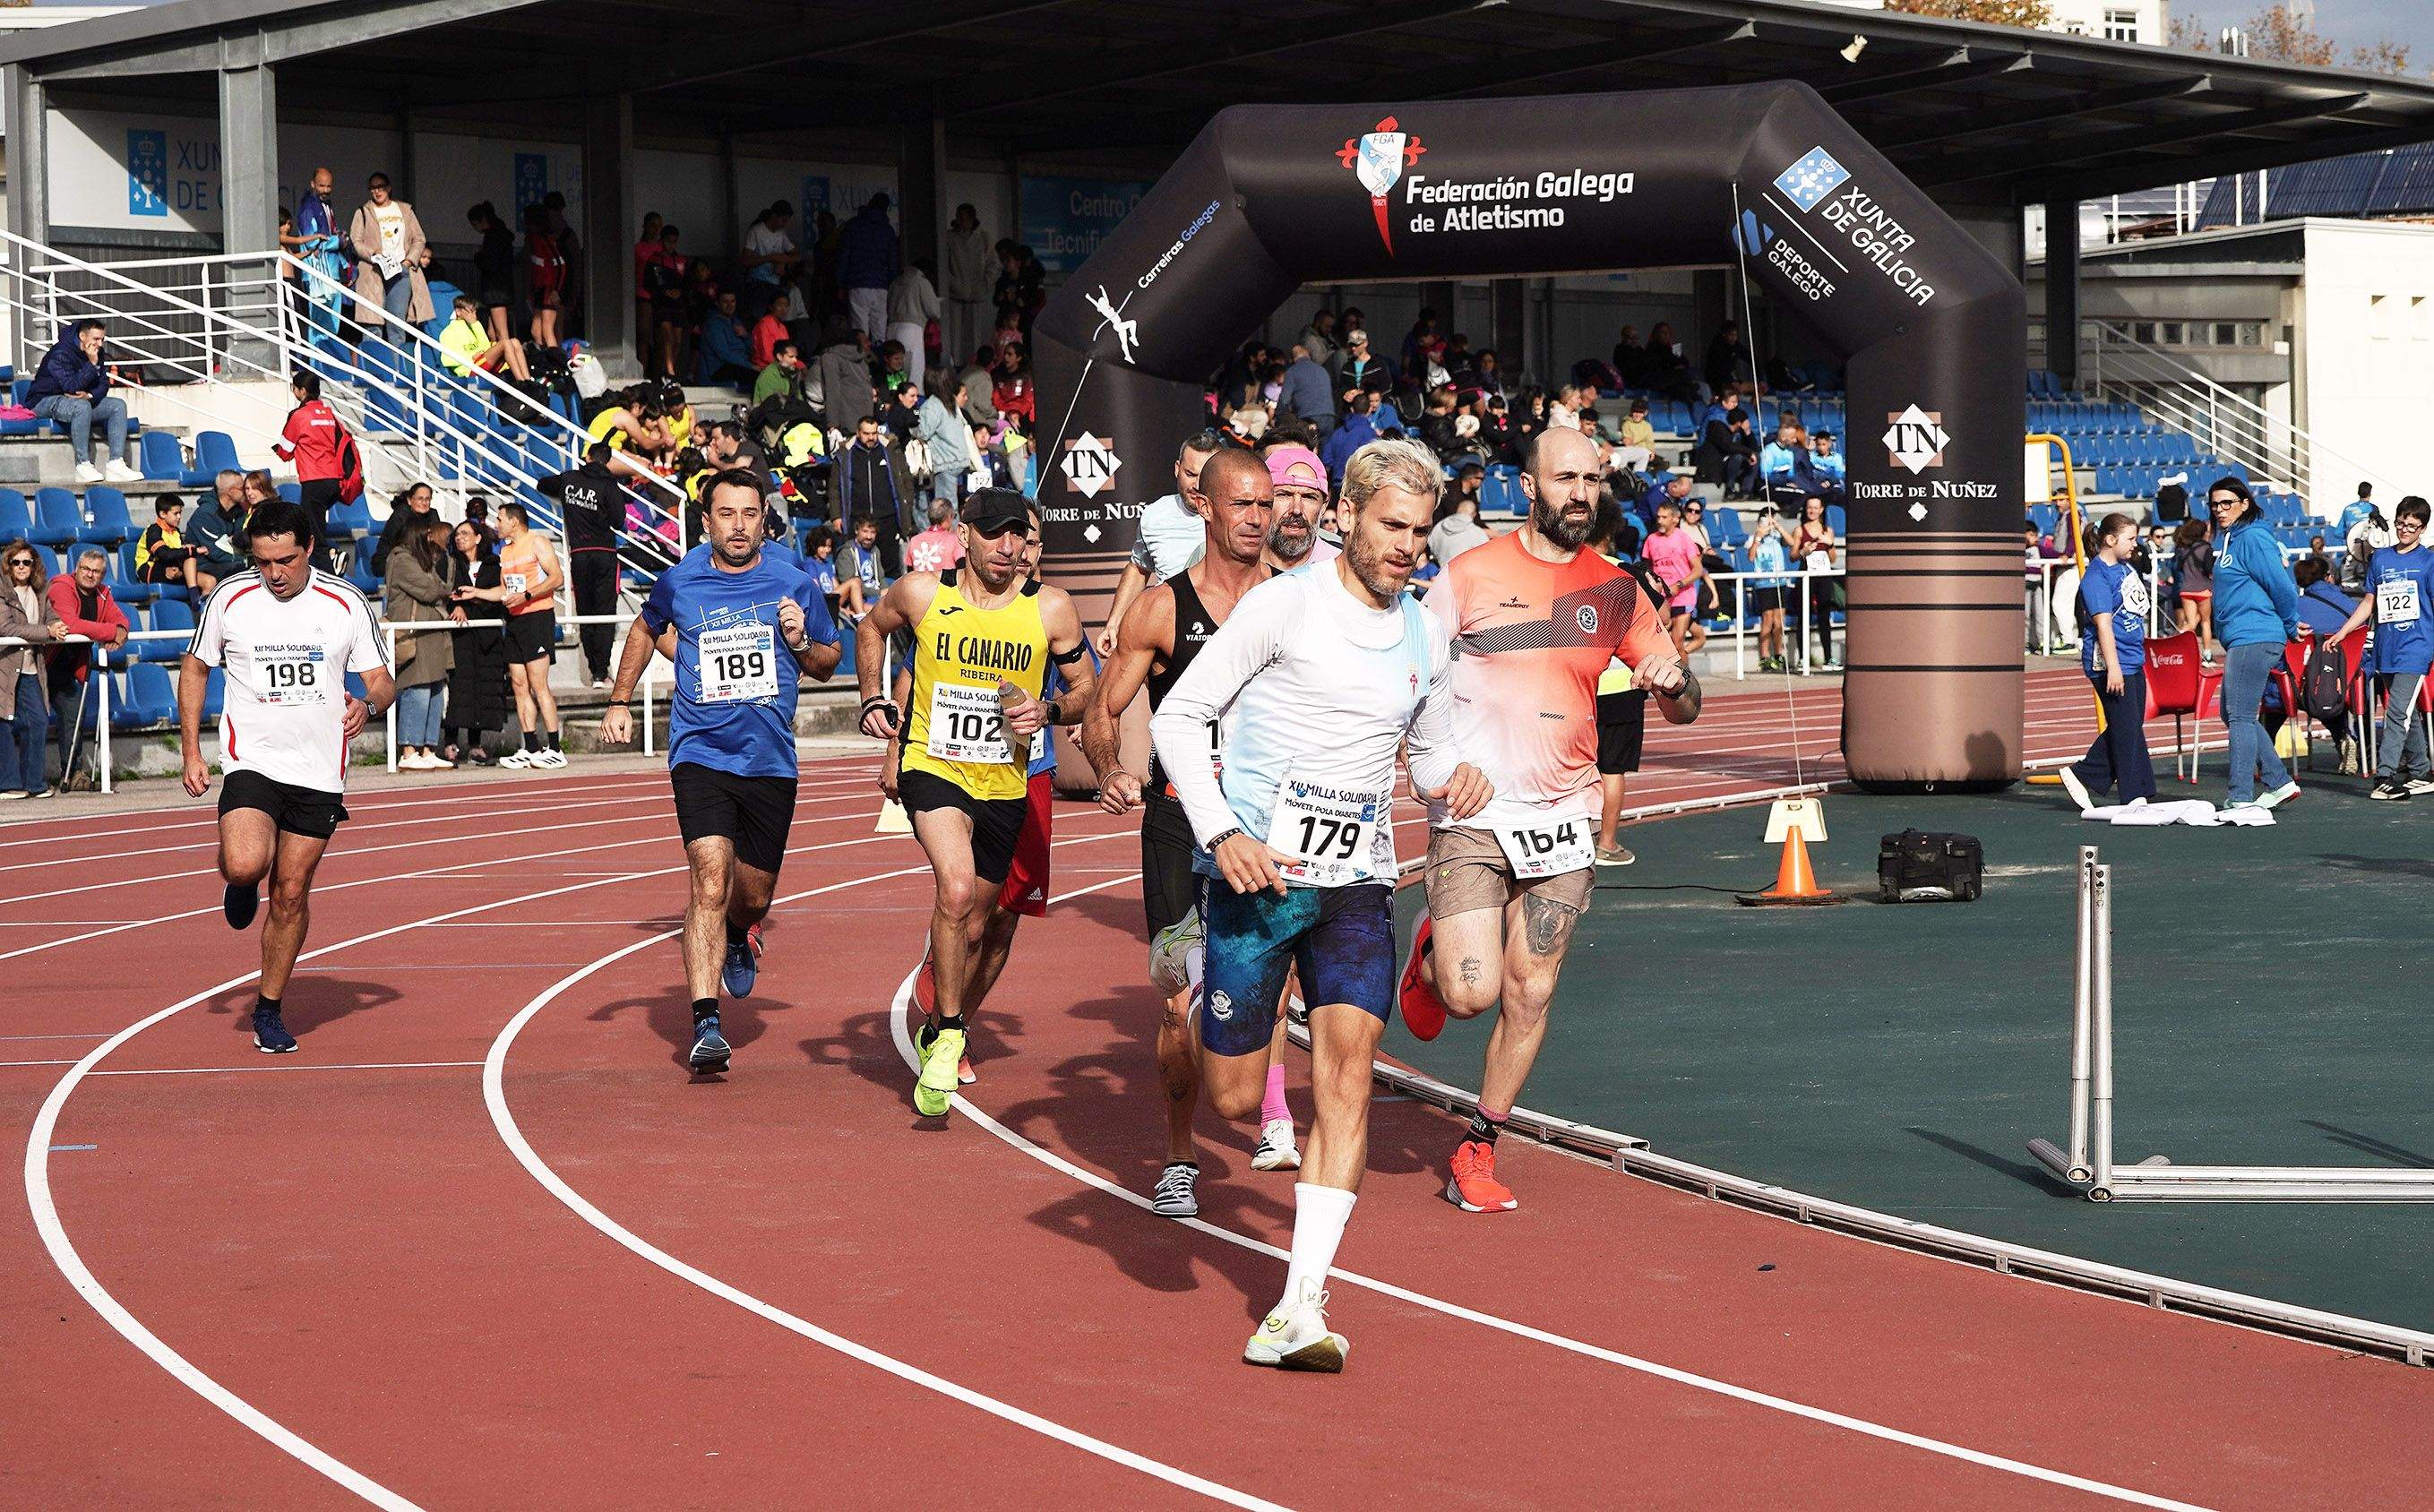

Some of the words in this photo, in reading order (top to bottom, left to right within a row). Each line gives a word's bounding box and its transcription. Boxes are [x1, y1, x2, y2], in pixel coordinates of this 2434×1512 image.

[1372, 134, 1395, 144] FGA
[177, 180, 208, 210] DE
[1406, 176, 1529, 204] Federación
[1535, 168, 1635, 202] Galega
[1070, 190, 1124, 217] Centro
[1410, 213, 1434, 233] de
[1443, 204, 1564, 232] Atletismo
[1841, 185, 1916, 253] XUNTA
[1138, 240, 1184, 288] Carreiras
[1181, 200, 1220, 242] Galegas
[1821, 200, 1857, 233] DE
[1851, 228, 1935, 306] GALICIA
[1767, 250, 1820, 301] GALEGO
[1775, 238, 1836, 297] DEPORTE
[1888, 423, 1941, 453] TN
[1065, 449, 1113, 478] TN
[565, 484, 598, 503] C.A.R.
[1853, 482, 1903, 499] TORRE
[1908, 486, 1926, 498] DE
[1931, 480, 1997, 498] NUÑEZ
[1084, 510, 1101, 520] DE
[1104, 502, 1148, 521] NUÑ
[2385, 595, 2411, 611] 122
[703, 637, 712, 645] XII
[712, 635, 733, 643] MILLA
[734, 631, 770, 640] SOLIDARIA
[936, 632, 950, 661] EL
[958, 636, 1032, 672] CANARIO
[265, 663, 315, 688] 198
[714, 652, 765, 681] 189
[960, 668, 1002, 682] RIBEIRA
[950, 690, 974, 700] MILLA
[976, 693, 1000, 703] SOLID
[948, 712, 1004, 743] 102
[1305, 783, 1337, 800] MILLA
[1338, 790, 1377, 804] SOLIDARIA
[1314, 806, 1333, 815] POLA
[1335, 810, 1361, 820] DIABETES
[1300, 816, 1361, 859] 179
[1512, 822, 1578, 857] 164
